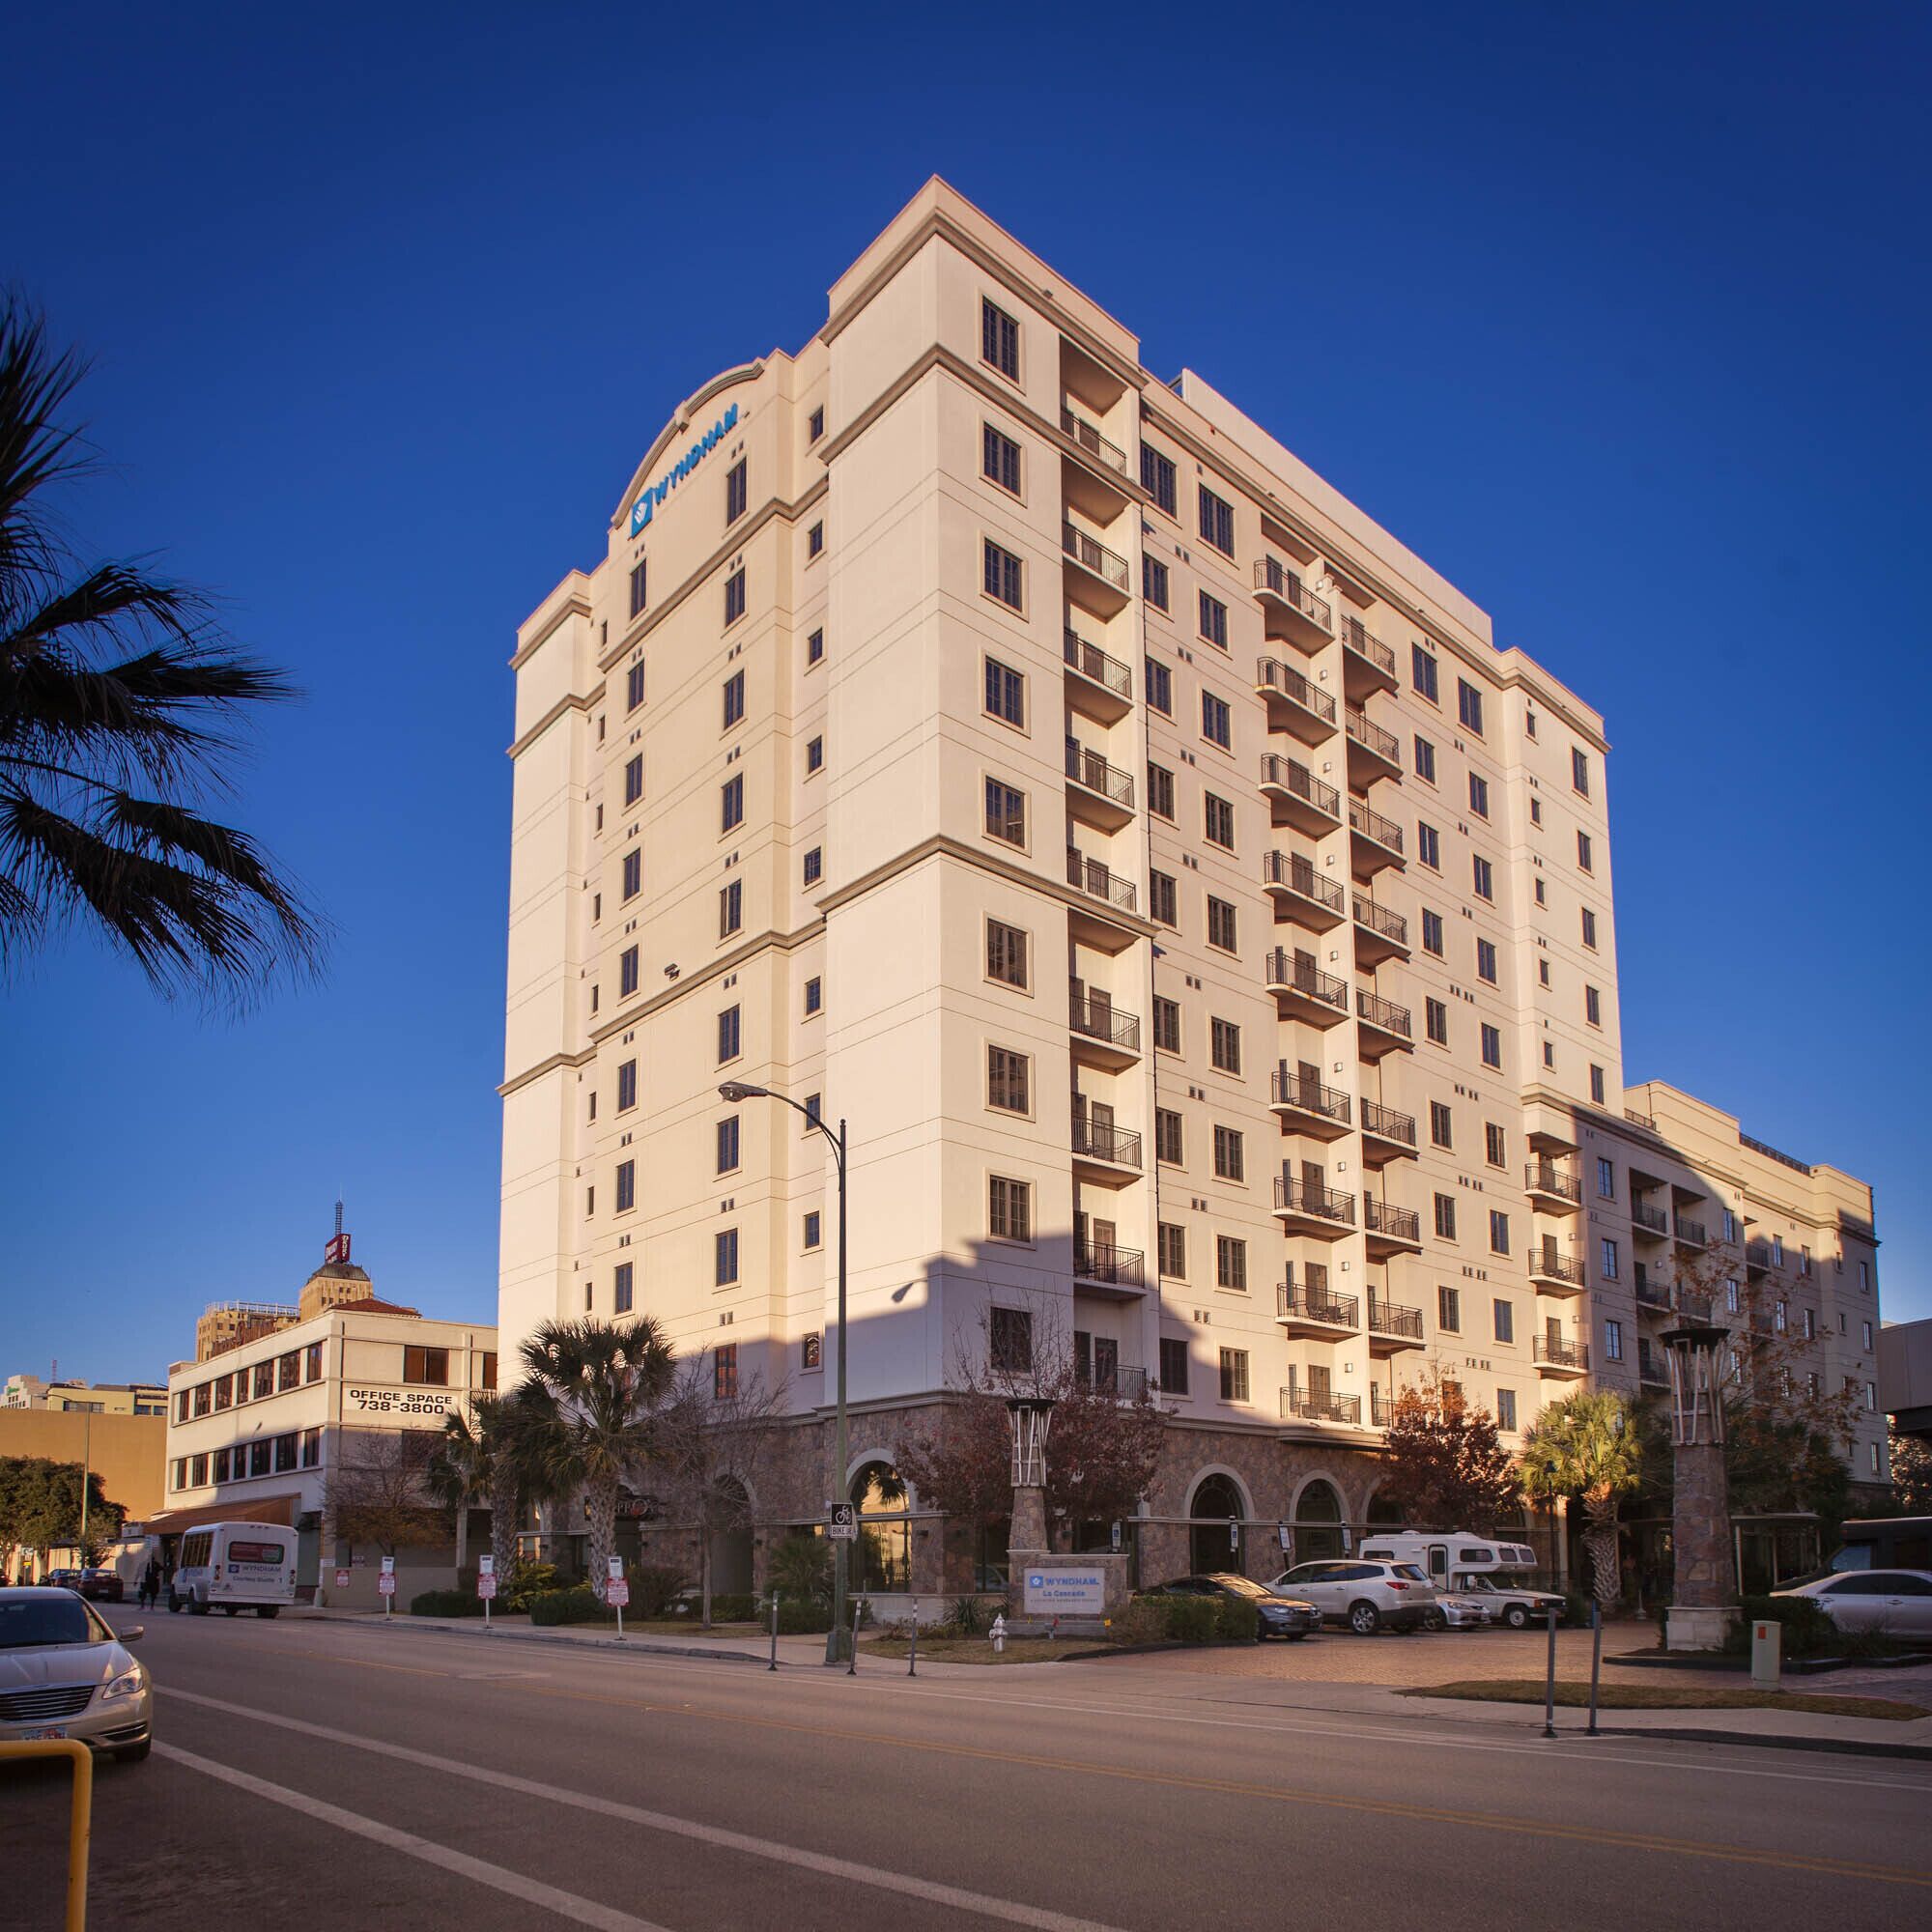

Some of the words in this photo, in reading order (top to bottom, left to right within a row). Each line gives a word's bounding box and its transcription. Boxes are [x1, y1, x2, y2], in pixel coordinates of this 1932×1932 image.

[654, 402, 738, 505] WYNDHAM
[350, 1389, 401, 1401] OFFICE
[407, 1394, 452, 1405] SPACE
[357, 1400, 444, 1414] 738-3800
[242, 1564, 282, 1573] WYNDHAM
[1045, 1577, 1097, 1585] WYNDHAM
